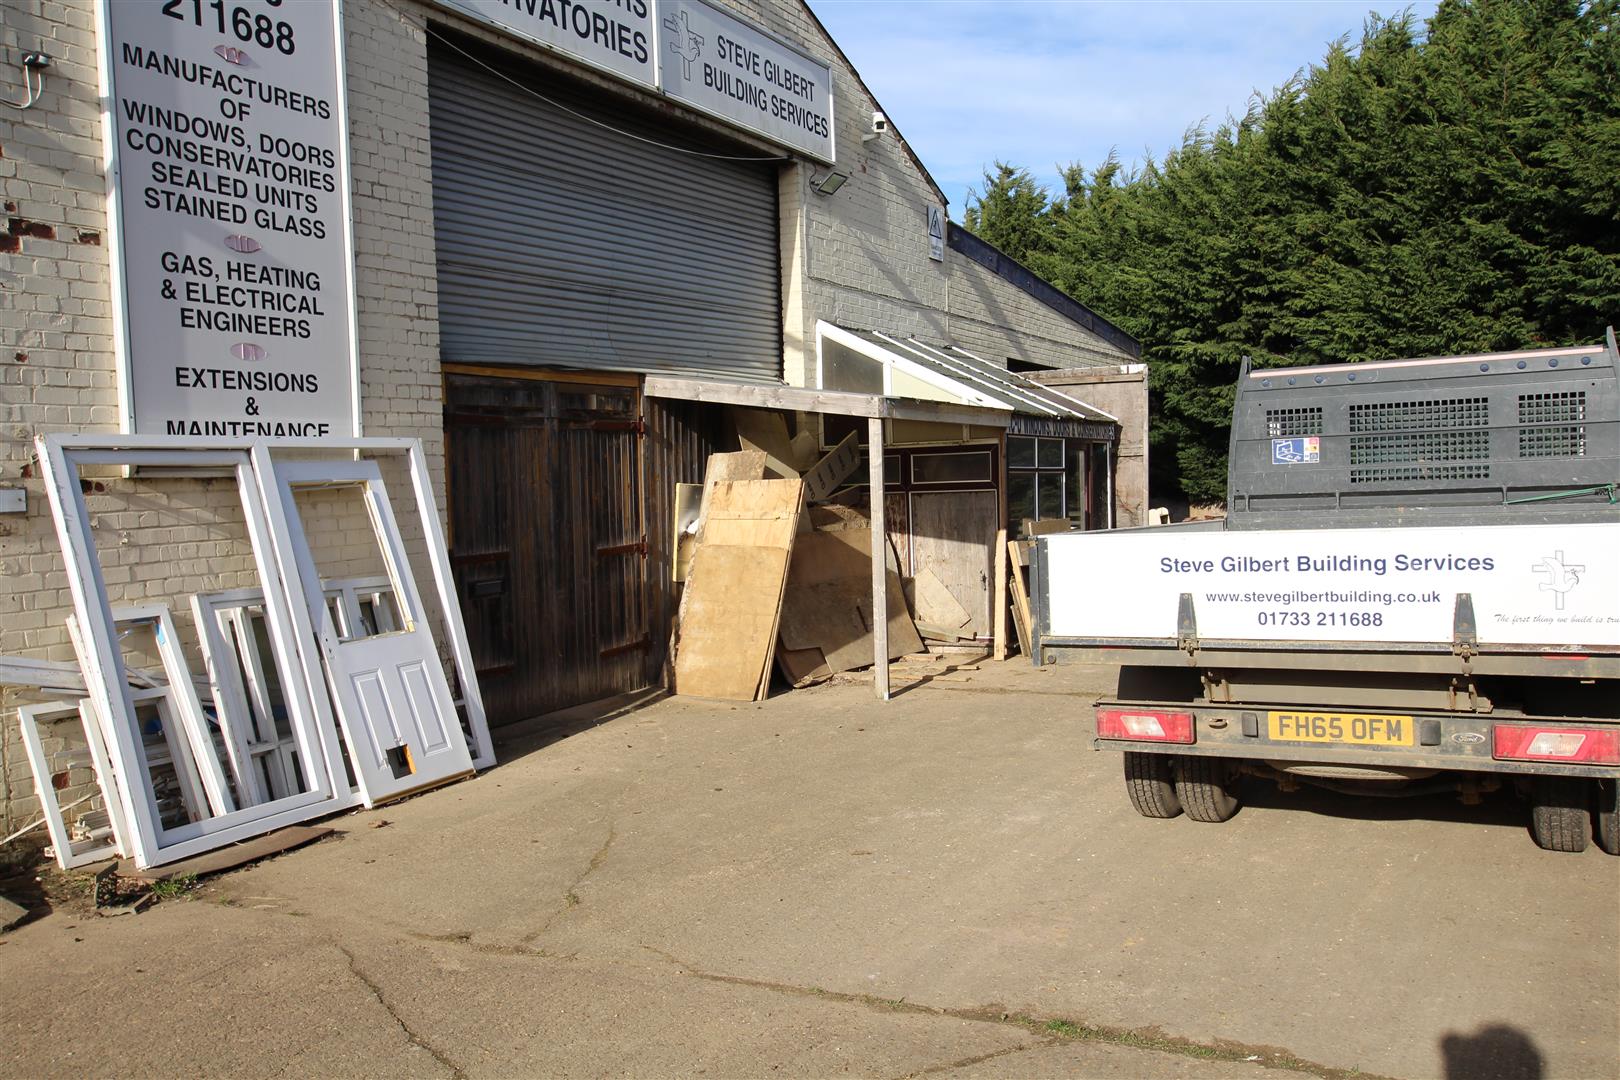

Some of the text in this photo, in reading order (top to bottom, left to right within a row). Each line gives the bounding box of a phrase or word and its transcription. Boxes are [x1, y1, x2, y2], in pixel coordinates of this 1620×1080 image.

[162, 0, 295, 55] 211688
[122, 42, 331, 119] MANUFACTURERS
[717, 35, 815, 102] STEVE GILBERT
[220, 98, 251, 121] OF
[704, 62, 828, 138] BUILDING SERVICES
[123, 99, 335, 169] WINDOWS, DOORS
[126, 128, 335, 193] CONSERVATORIES
[152, 161, 318, 213] SEALED UNITS
[144, 187, 326, 239] STAINED GLASS
[161, 251, 321, 291] GAS, HEATING
[160, 278, 324, 316] & ELECTRICAL
[180, 307, 311, 339] ENGINEERS
[175, 367, 318, 393] EXTENSIONS
[245, 396, 260, 416] &
[167, 420, 329, 437] MAINTENANCE
[1160, 554, 1495, 576] Steve Gilbert Building Services
[1206, 590, 1441, 606] www.stevegilbertbuilding.co.uk
[1258, 612, 1383, 627] 01733 211688
[1278, 715, 1401, 741] FH65 OFM
